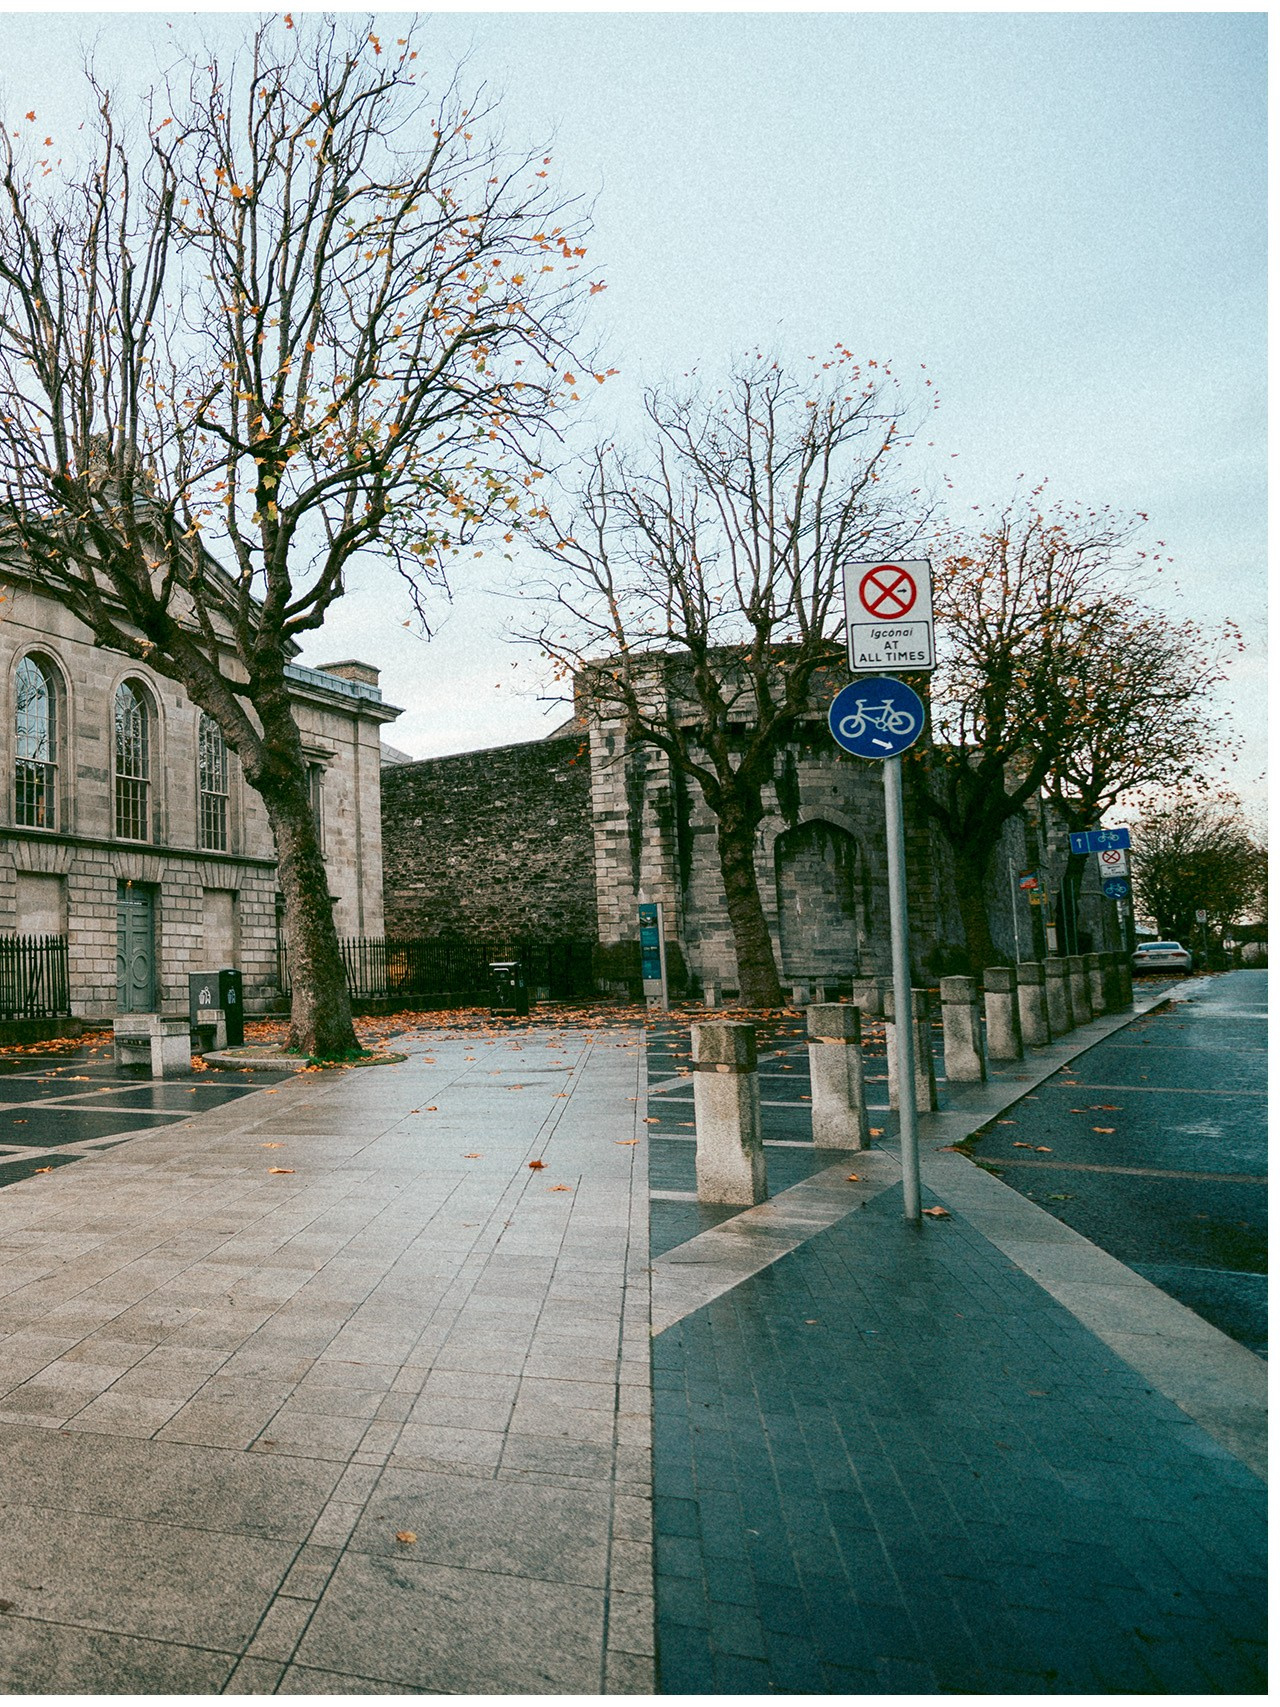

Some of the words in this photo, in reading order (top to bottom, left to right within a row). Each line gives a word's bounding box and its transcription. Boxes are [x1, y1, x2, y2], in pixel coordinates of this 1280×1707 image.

[884, 640, 899, 650] AT
[859, 653, 882, 662] ALL
[885, 651, 925, 661] TIMES
